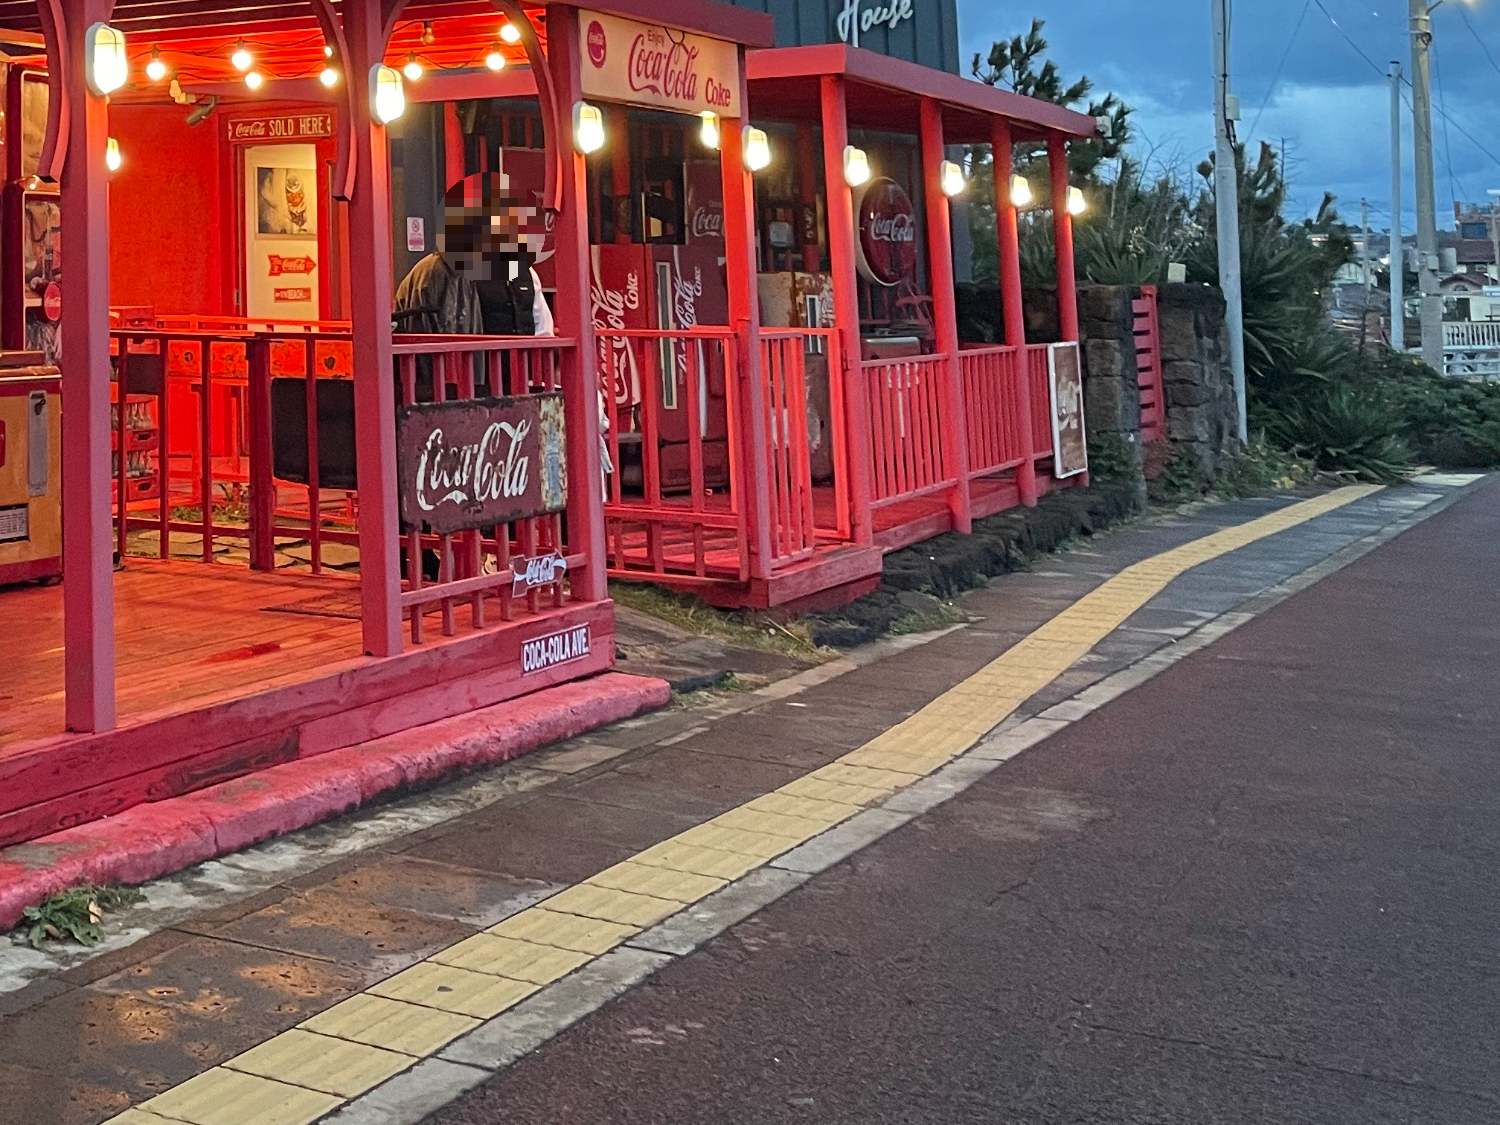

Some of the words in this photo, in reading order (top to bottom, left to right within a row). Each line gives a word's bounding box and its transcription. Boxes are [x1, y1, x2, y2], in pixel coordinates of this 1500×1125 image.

[647, 29, 666, 48] Enjoy
[627, 33, 700, 101] Coca-Cola
[705, 76, 732, 108] Coke
[235, 121, 266, 137] Coca-Cola
[268, 119, 294, 137] SOLD
[299, 116, 325, 135] HERE
[871, 212, 915, 242] Coca-Cola
[624, 272, 639, 310] Coke
[416, 417, 533, 511] Coca-Cola
[523, 633, 571, 672] COCA-COLA
